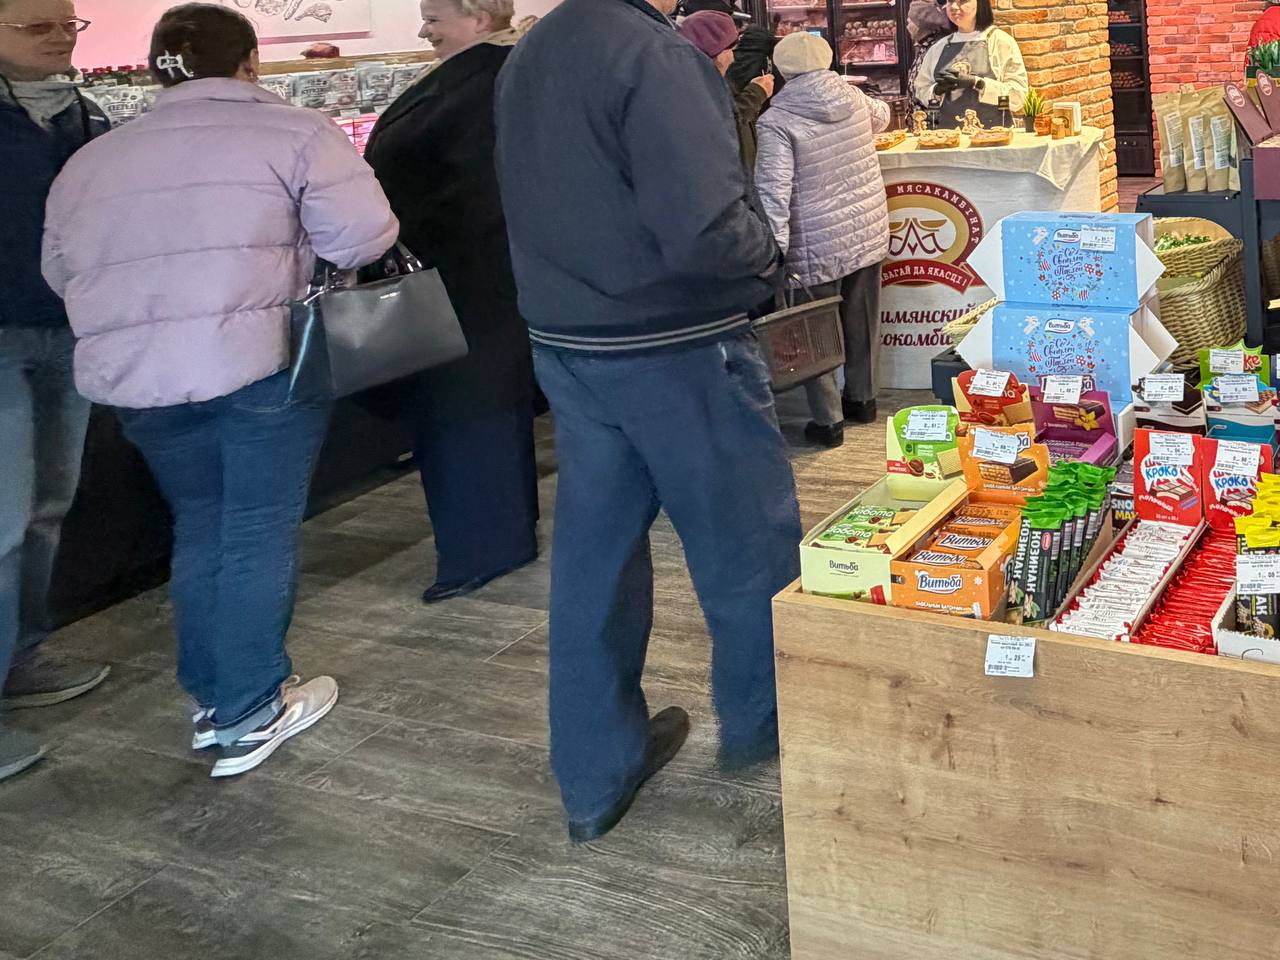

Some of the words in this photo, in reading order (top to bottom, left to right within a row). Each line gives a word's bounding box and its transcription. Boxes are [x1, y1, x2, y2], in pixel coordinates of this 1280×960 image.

[882, 266, 912, 280] ВАГАЙ
[913, 266, 925, 276] ДА
[1146, 466, 1178, 480] КРОКО
[1215, 475, 1249, 490] КРОКО
[1111, 498, 1135, 510] SNO
[1012, 519, 1031, 580] КОЗИНАК
[829, 559, 859, 572] Витьба
[1026, 530, 1043, 593] КОЗИНАК
[919, 573, 962, 589] Витьба
